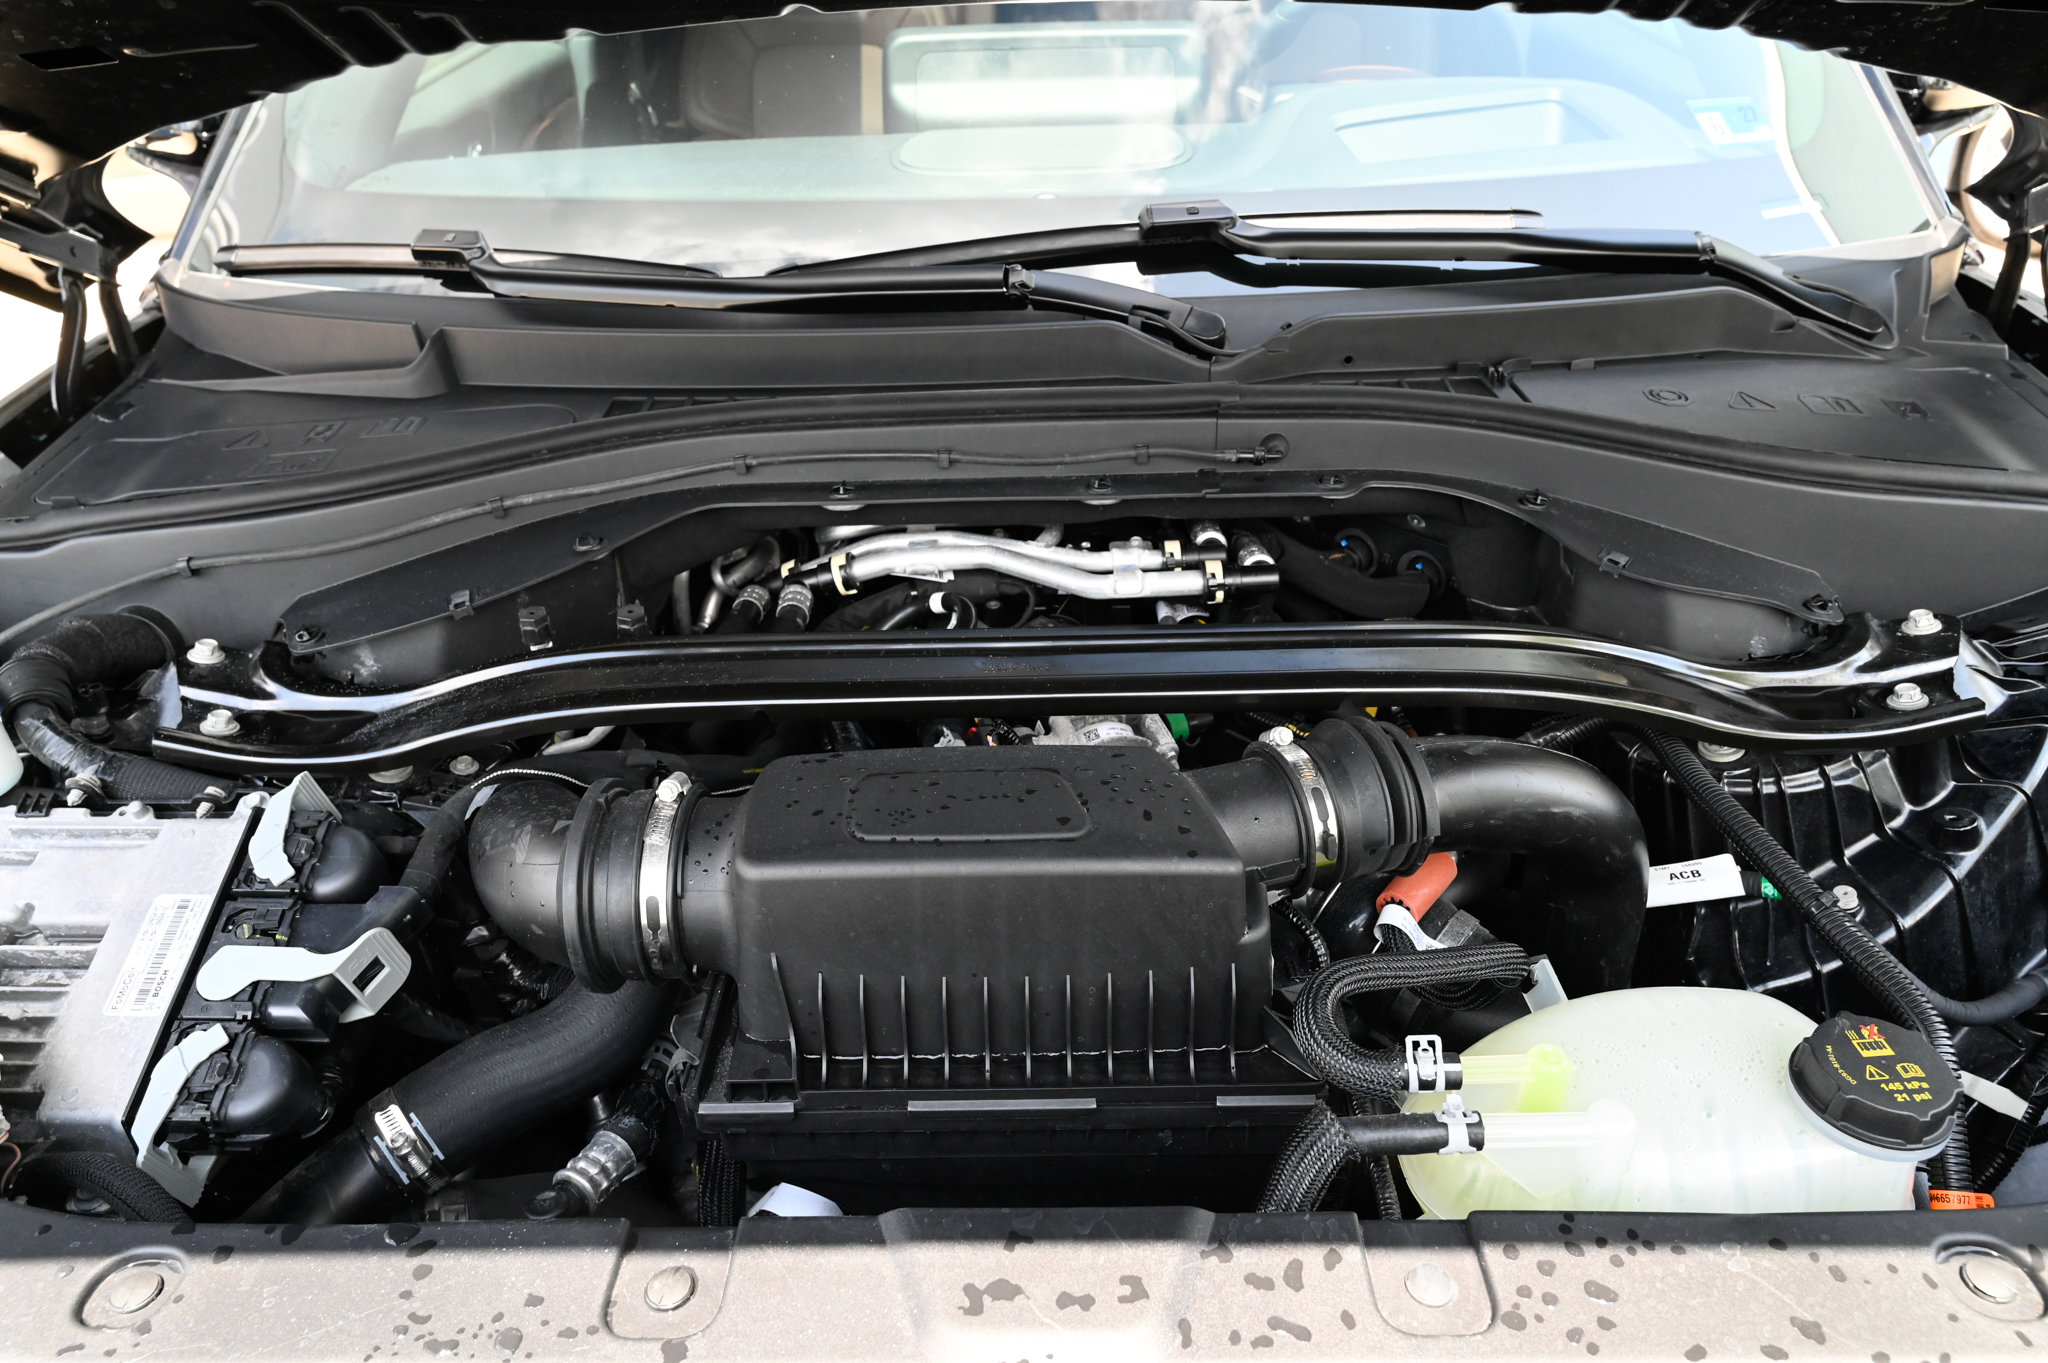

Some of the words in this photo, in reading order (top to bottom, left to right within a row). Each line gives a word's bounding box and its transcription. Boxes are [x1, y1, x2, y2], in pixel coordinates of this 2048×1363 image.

[1669, 869, 1702, 881] ACB
[152, 969, 169, 998] BOSCH
[111, 973, 135, 1010] FoMoCo
[1880, 1082, 1905, 1091] 145
[1904, 1081, 1930, 1090] kPa
[1893, 1092, 1911, 1102] 21
[1912, 1091, 1933, 1103] psi
